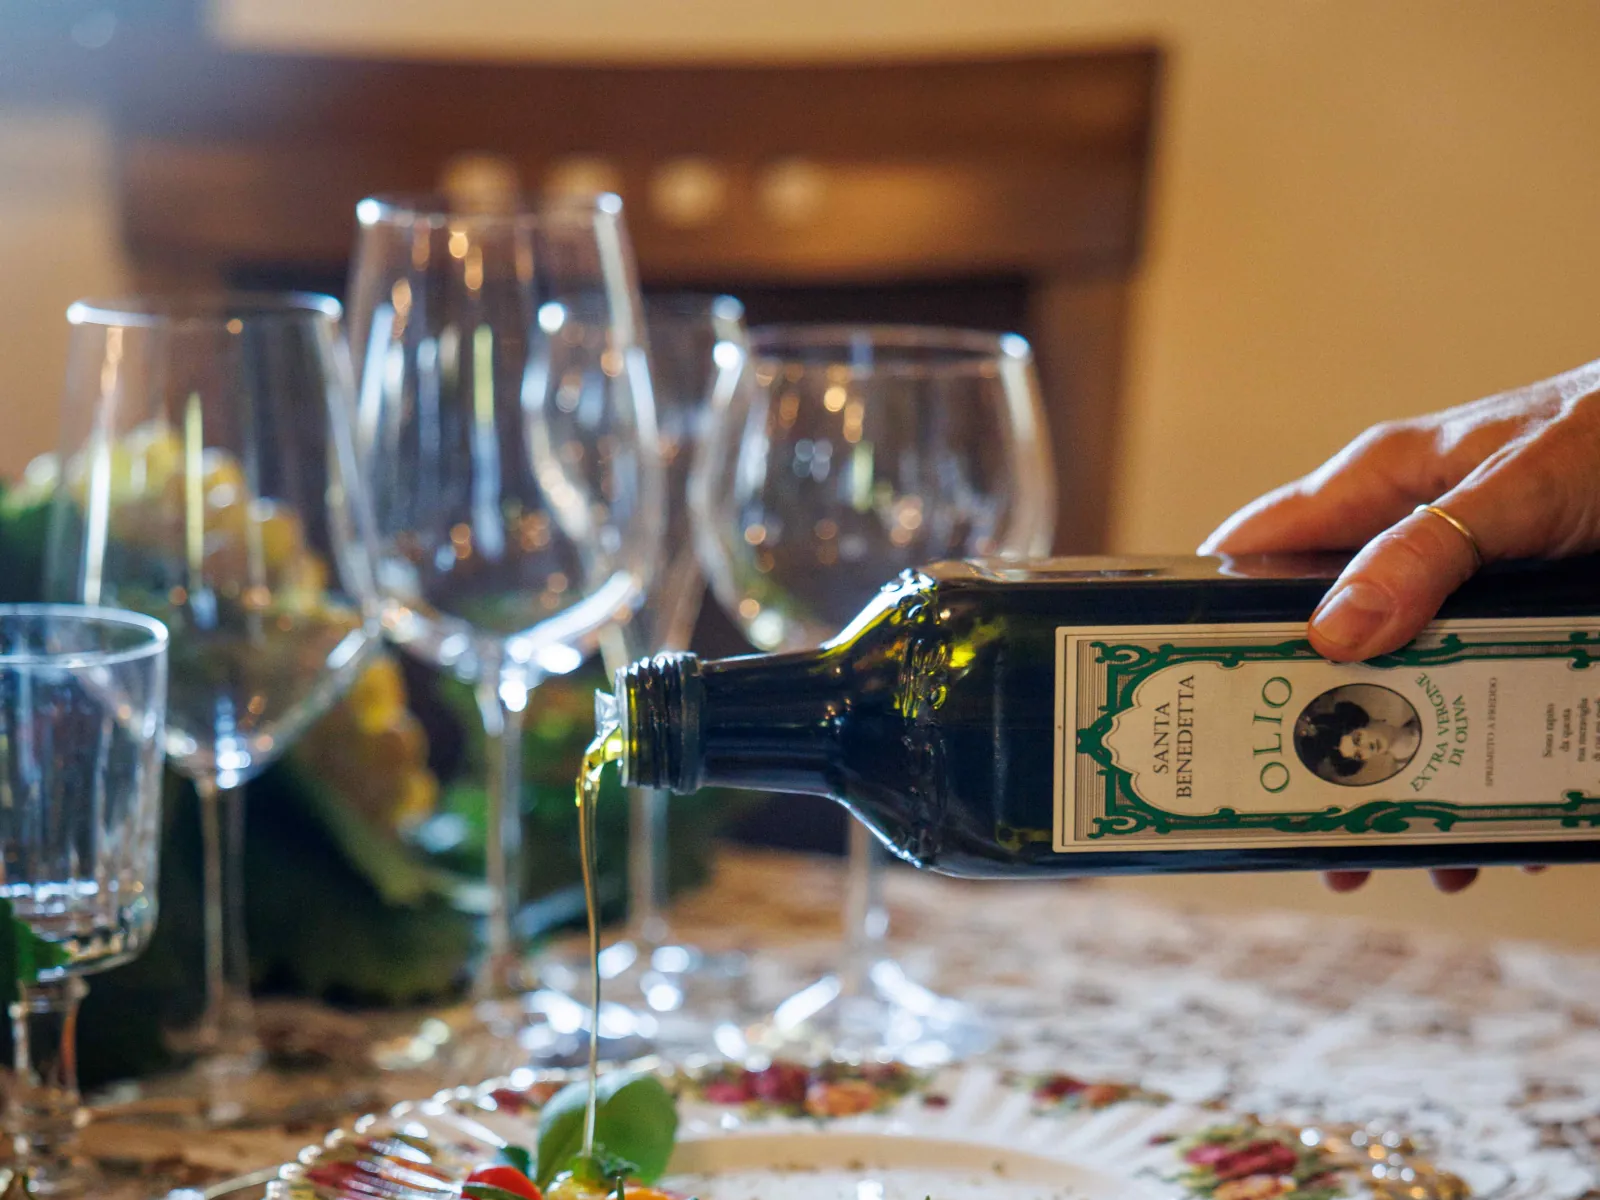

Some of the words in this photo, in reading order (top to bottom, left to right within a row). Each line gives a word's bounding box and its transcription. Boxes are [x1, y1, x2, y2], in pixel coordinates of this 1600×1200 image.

[1415, 672, 1450, 736] VERGINE
[1452, 694, 1468, 744] OLIVA
[1546, 703, 1557, 731] rapito
[1562, 708, 1573, 738] questa
[1153, 701, 1171, 775] SANTA
[1176, 674, 1195, 799] BENEDETTA
[1252, 676, 1293, 793] OLIO
[1448, 748, 1465, 767] DI
[1543, 733, 1554, 758] Sono
[1559, 741, 1570, 752] da
[1410, 741, 1449, 792] EXTRA
